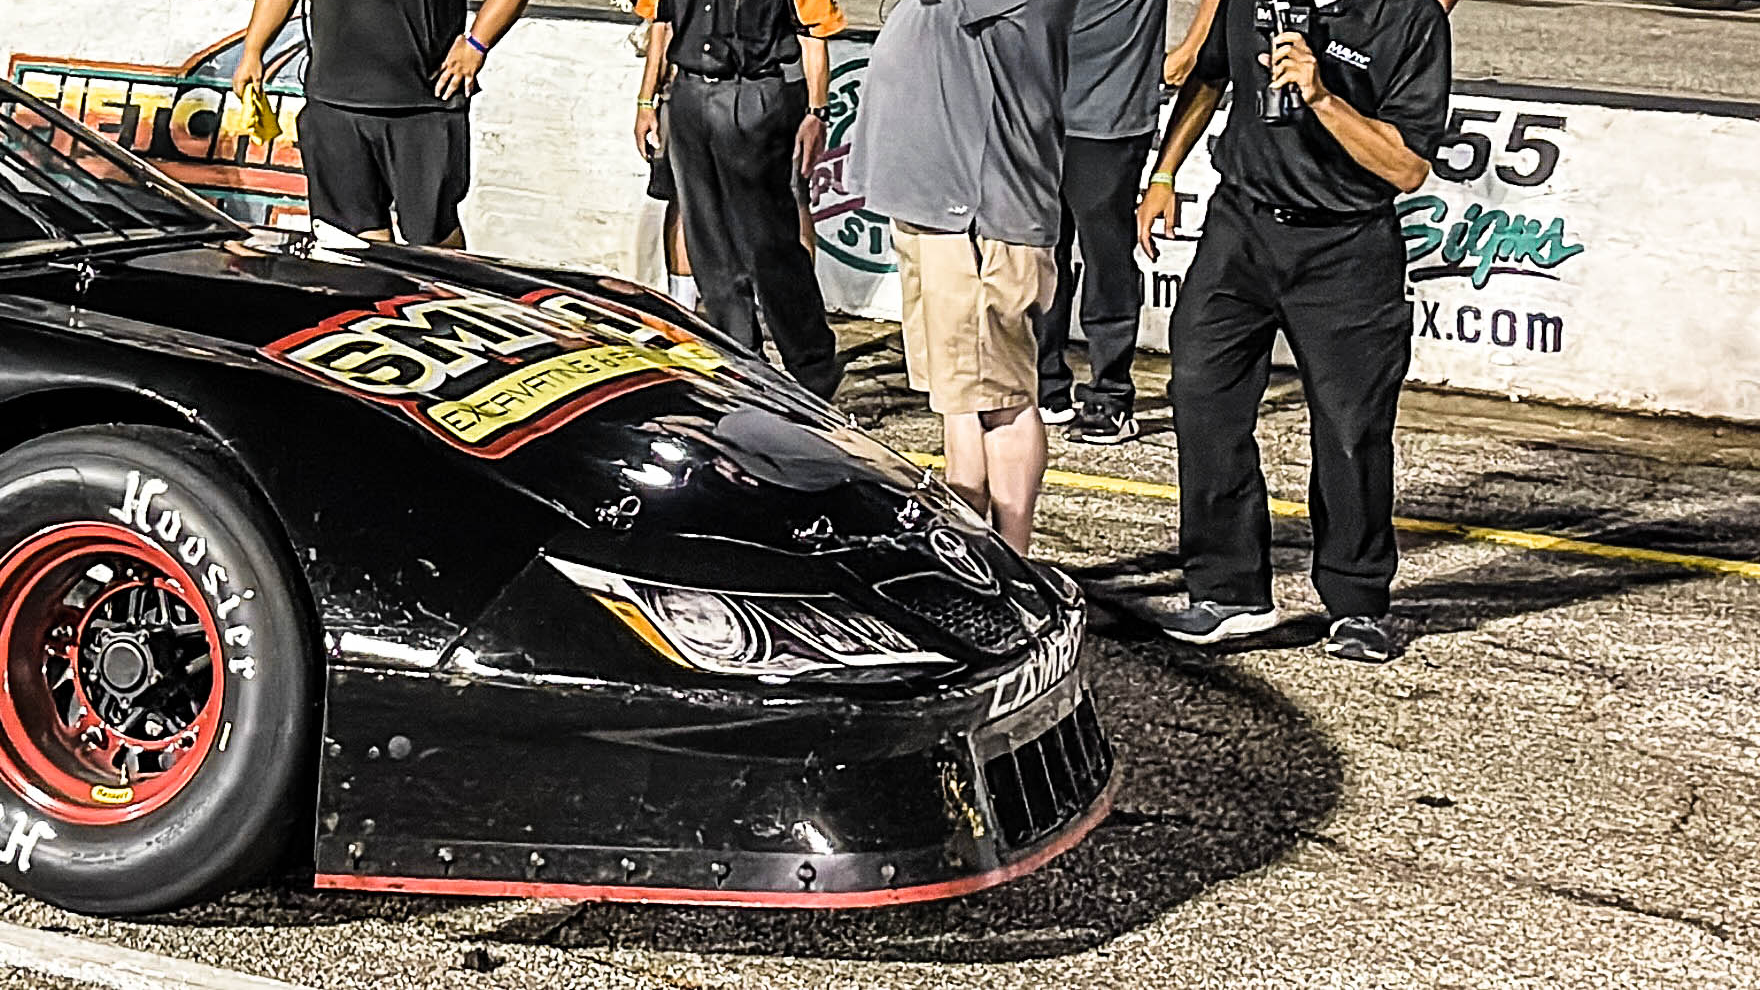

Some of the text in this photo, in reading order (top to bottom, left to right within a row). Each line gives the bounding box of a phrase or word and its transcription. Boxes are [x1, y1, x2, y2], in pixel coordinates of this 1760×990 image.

[1396, 194, 1585, 291] Signs
[442, 354, 601, 432] EXCAVATING
[109, 470, 258, 681] Hoosier
